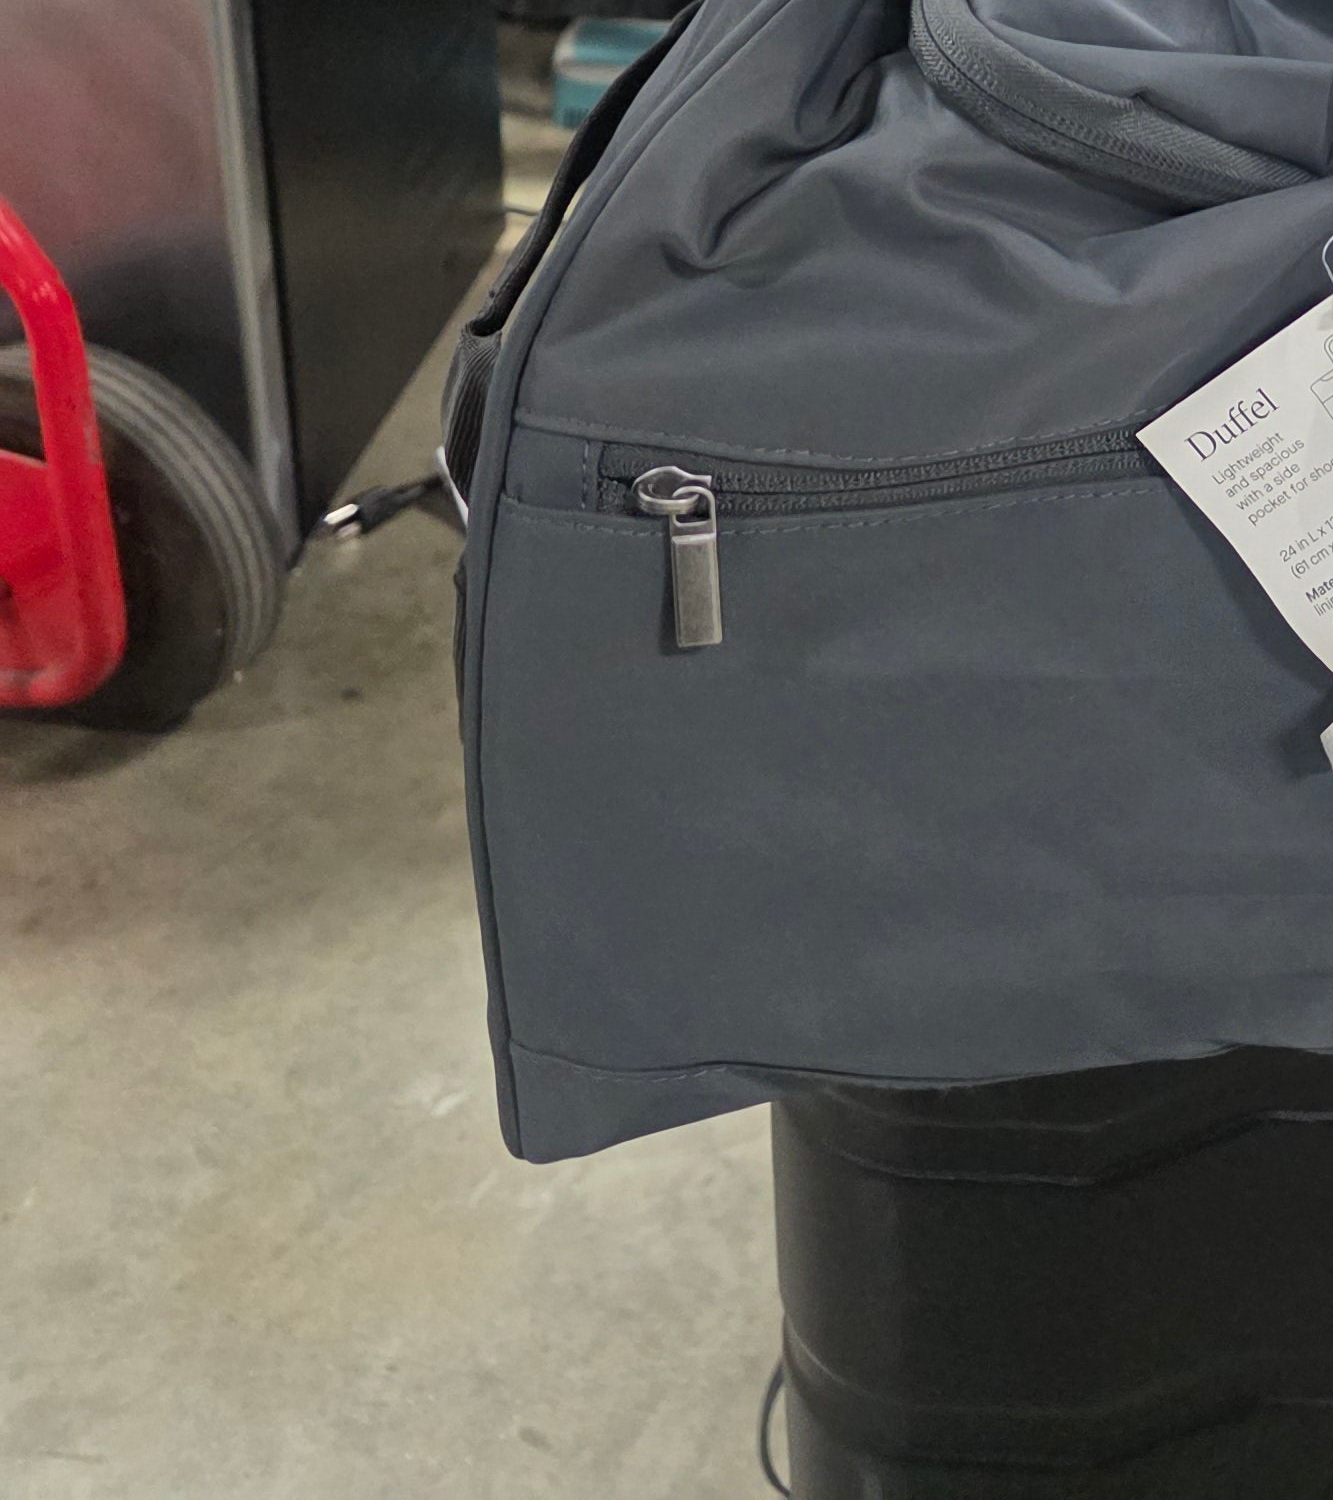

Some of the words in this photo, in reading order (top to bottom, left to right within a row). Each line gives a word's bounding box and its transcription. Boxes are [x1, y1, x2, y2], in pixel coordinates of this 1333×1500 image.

[1186, 388, 1277, 460] Duffel
[1211, 432, 1283, 484] Lightweight
[1225, 475, 1249, 497] and
[1249, 439, 1304, 481] spacious
[1236, 489, 1264, 510] with
[1263, 483, 1273, 492] a
[1272, 463, 1300, 485] side
[1247, 490, 1291, 526] pocket
[1289, 477, 1308, 493] for
[1279, 544, 1296, 562] 24
[1294, 538, 1309, 550] in
[1307, 532, 1318, 542] L
[1316, 526, 1326, 536] x
[1290, 559, 1309, 578] (61
[1309, 547, 1329, 565] cm
